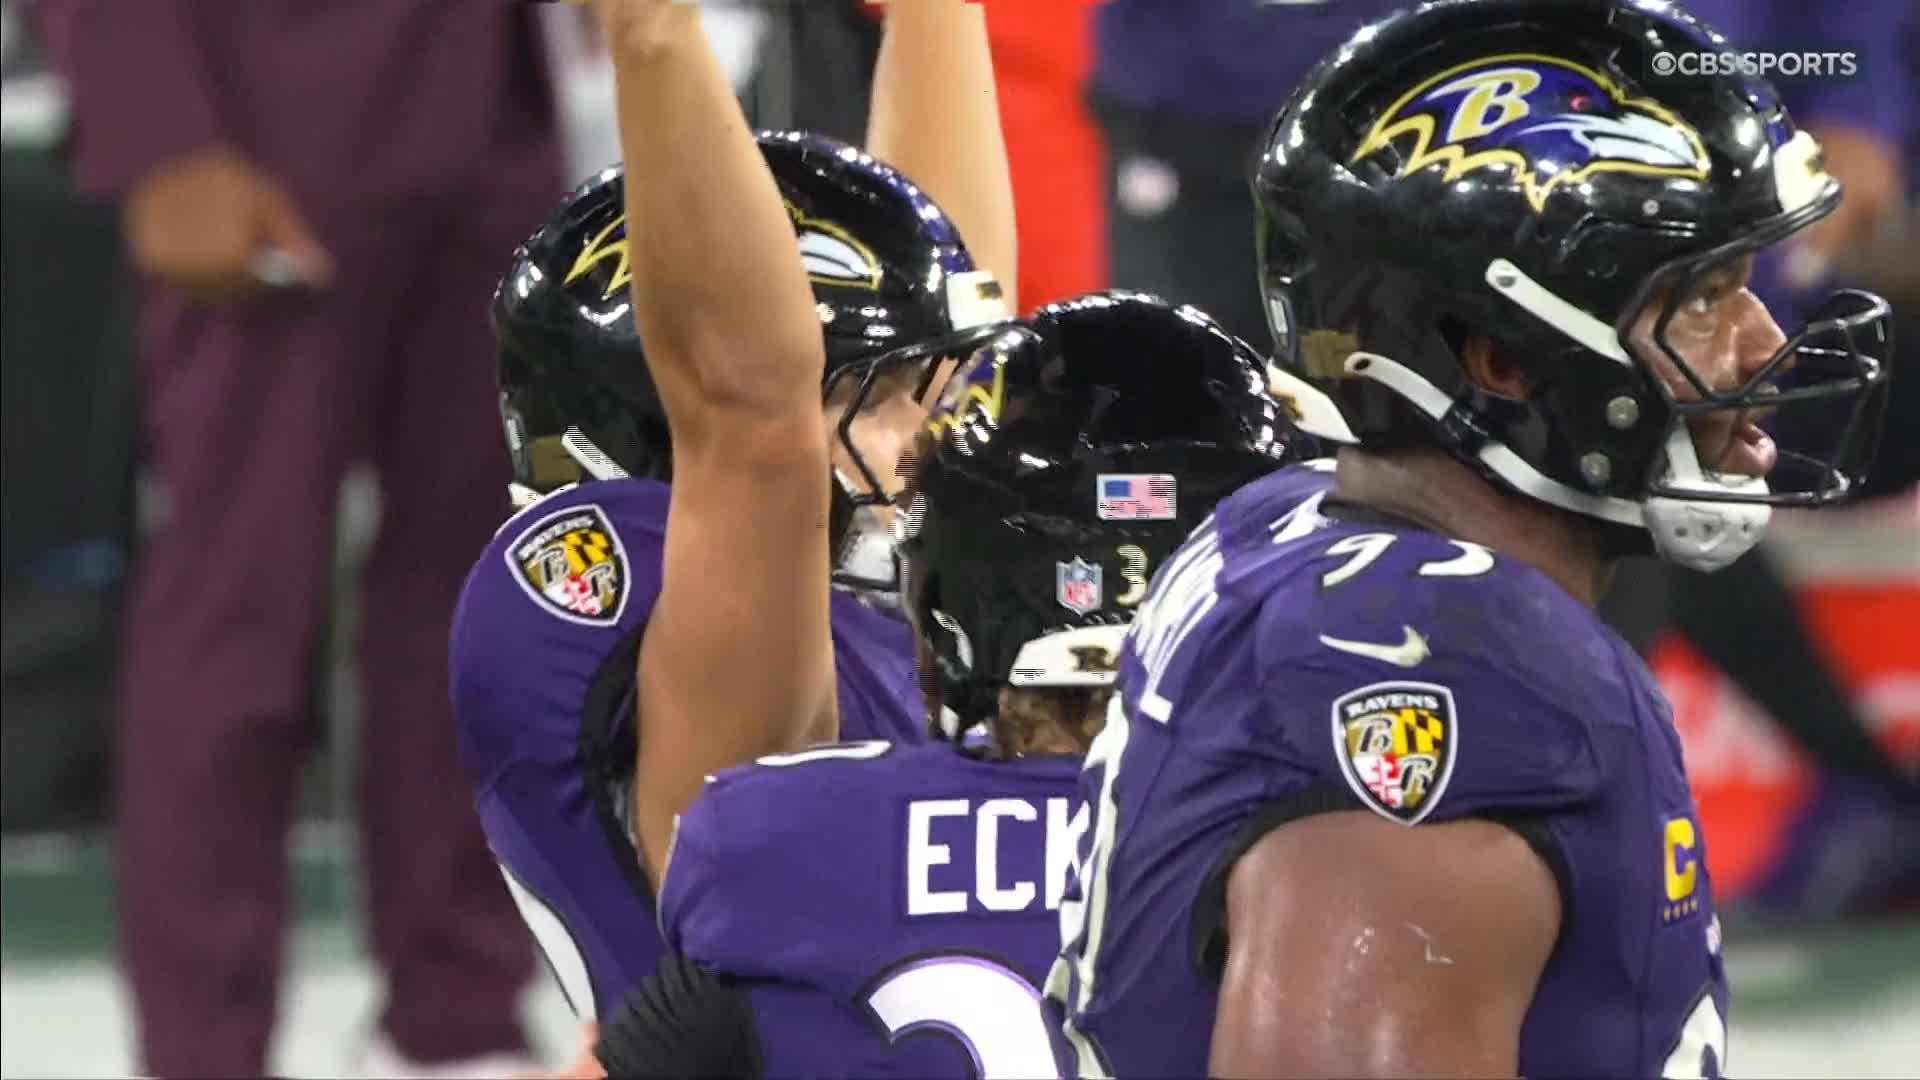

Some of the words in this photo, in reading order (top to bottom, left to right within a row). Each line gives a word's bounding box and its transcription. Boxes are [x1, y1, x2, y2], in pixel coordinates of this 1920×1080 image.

[1424, 67, 1541, 143] B
[1345, 692, 1440, 718] RAVENS
[1663, 817, 1697, 902] C
